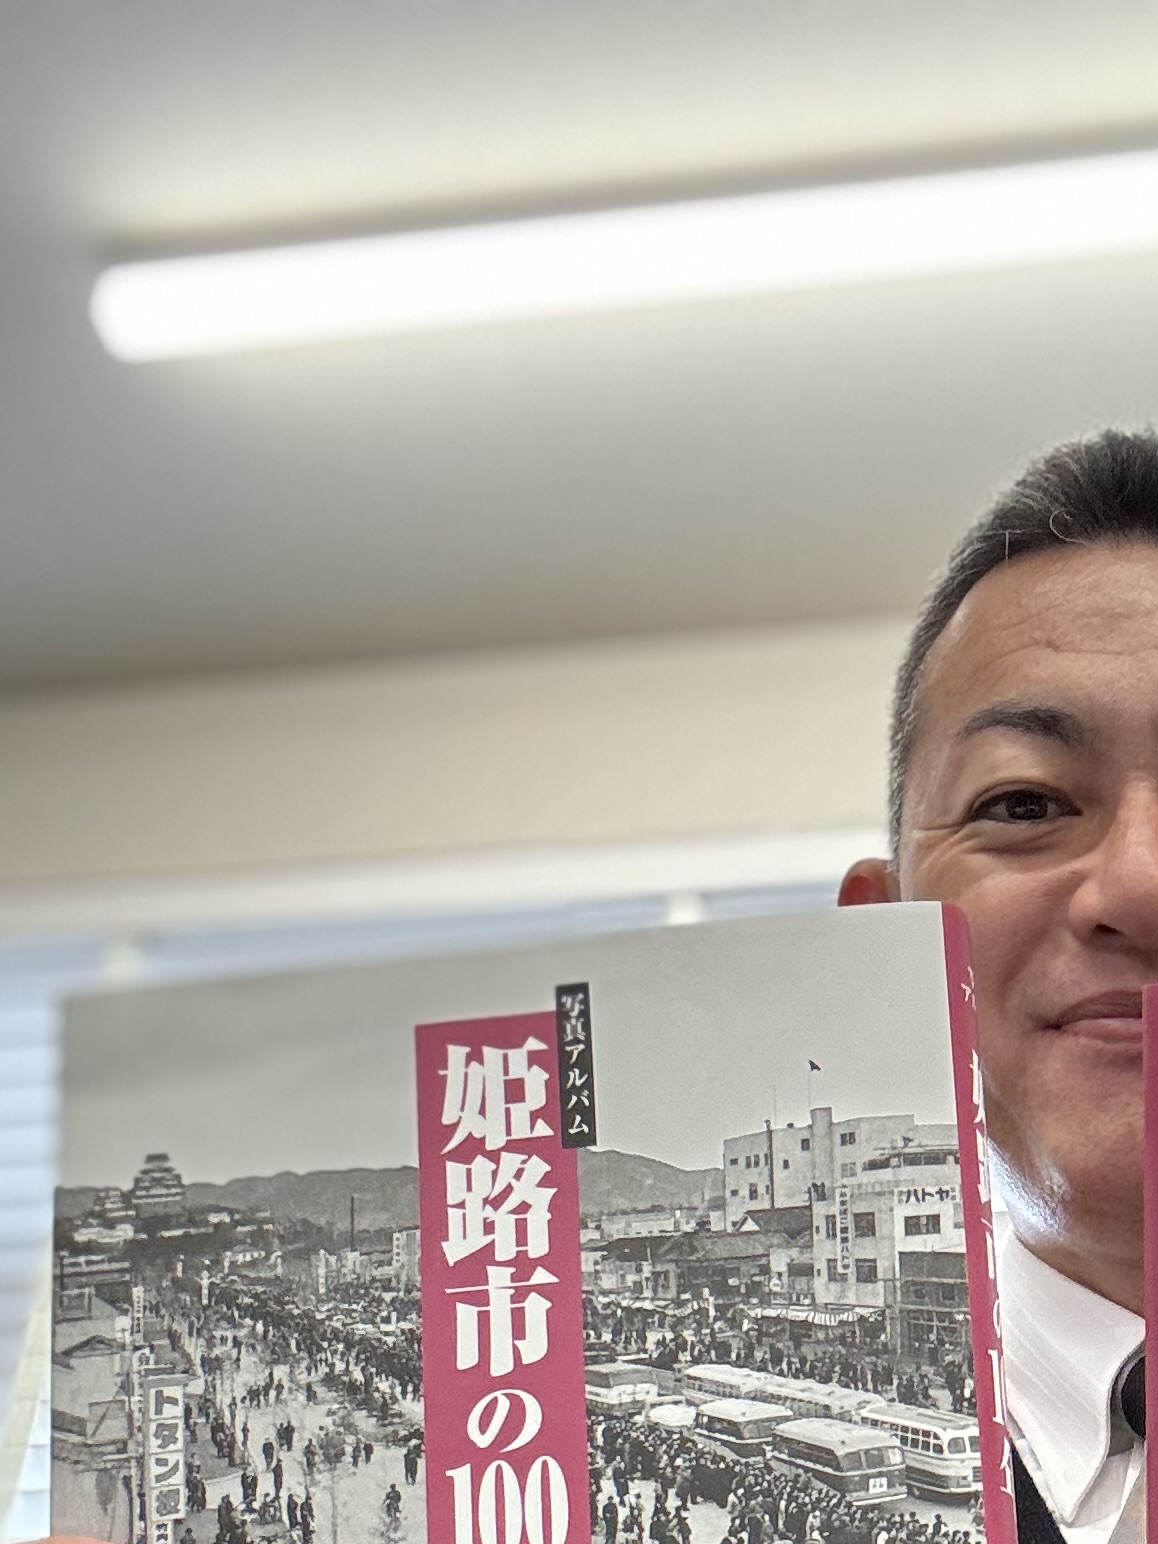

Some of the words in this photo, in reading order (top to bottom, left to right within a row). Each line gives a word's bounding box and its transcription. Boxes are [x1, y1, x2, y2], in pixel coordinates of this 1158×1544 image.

[561, 993, 590, 1135] 写真アルバム
